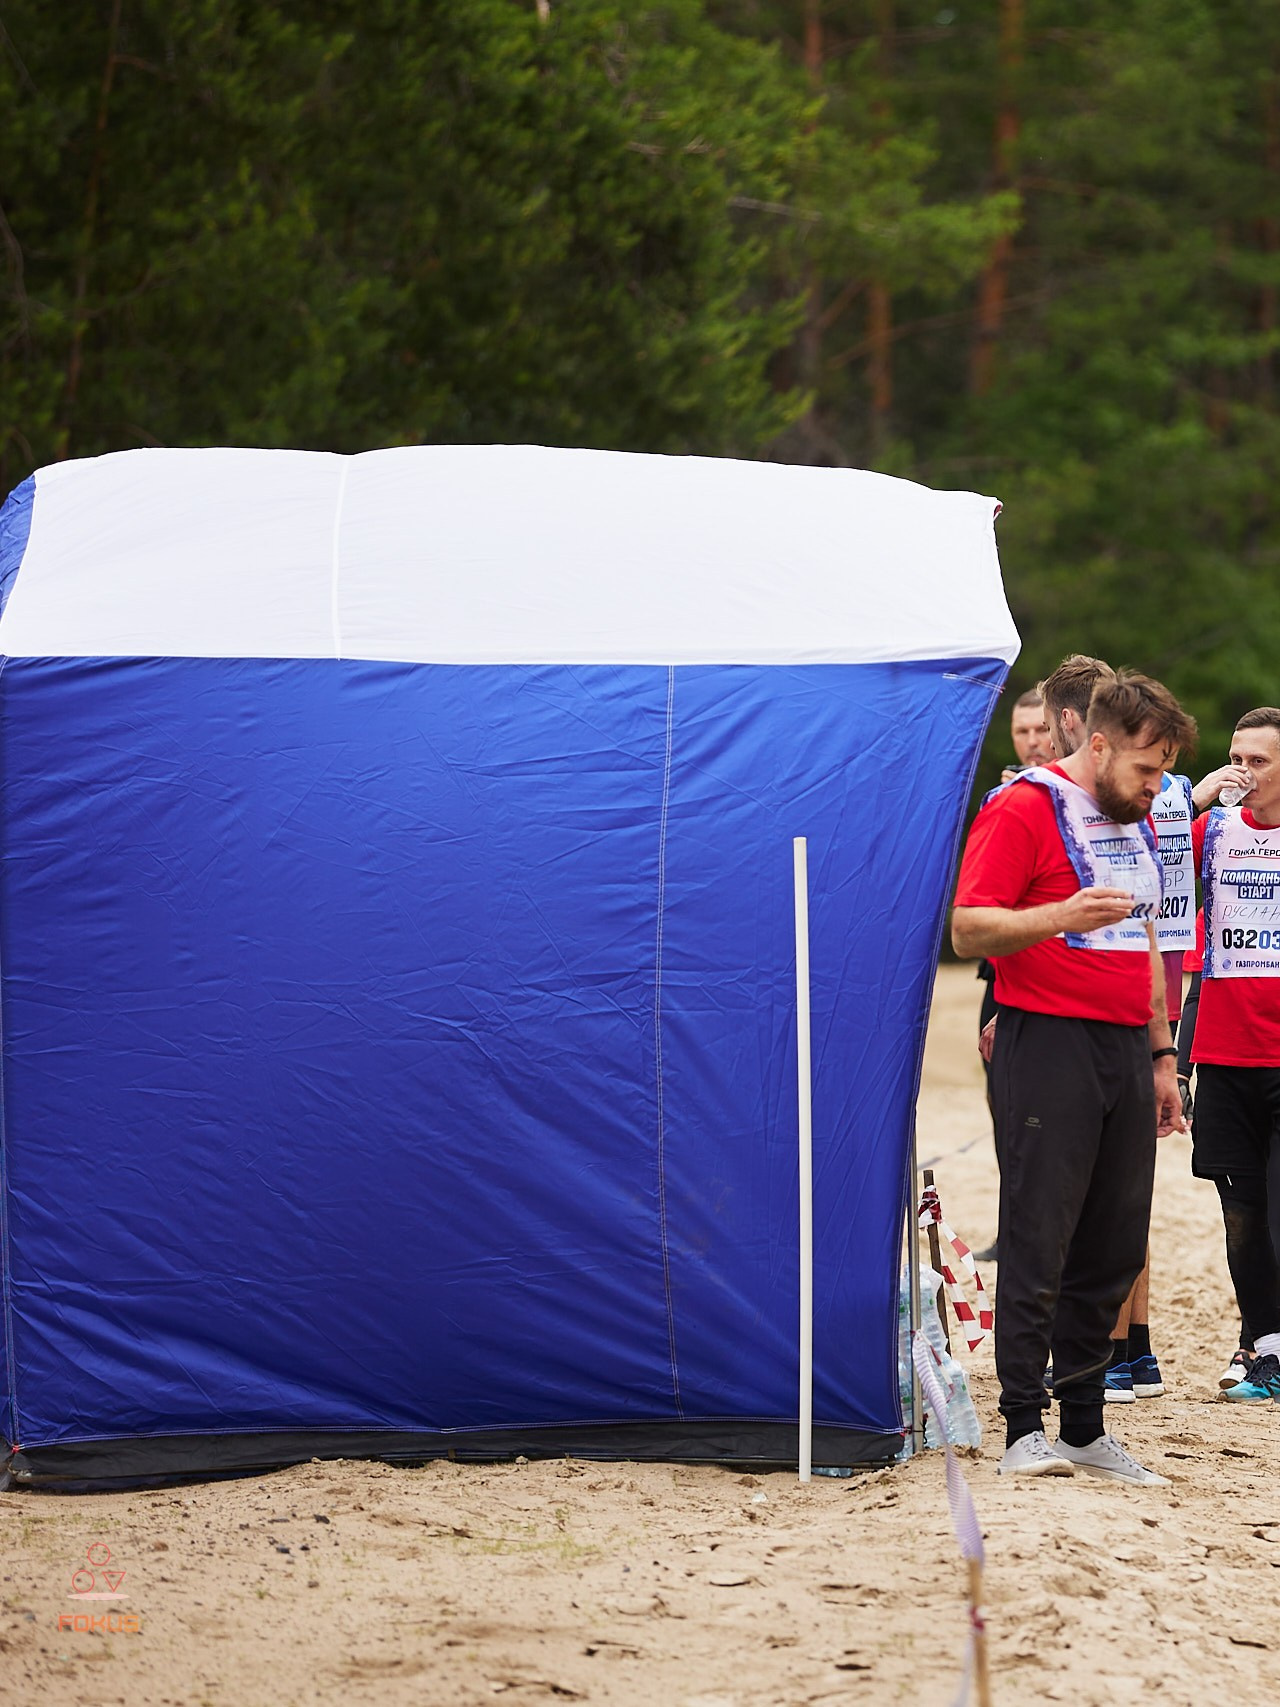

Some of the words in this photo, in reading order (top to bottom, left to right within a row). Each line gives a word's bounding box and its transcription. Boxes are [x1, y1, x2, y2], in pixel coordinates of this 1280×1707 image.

[1162, 851, 1183, 866] СТАРТ
[1228, 848, 1256, 856] ГОНКА
[1239, 886, 1272, 899] СТАРТ
[1156, 896, 1189, 919] 3207
